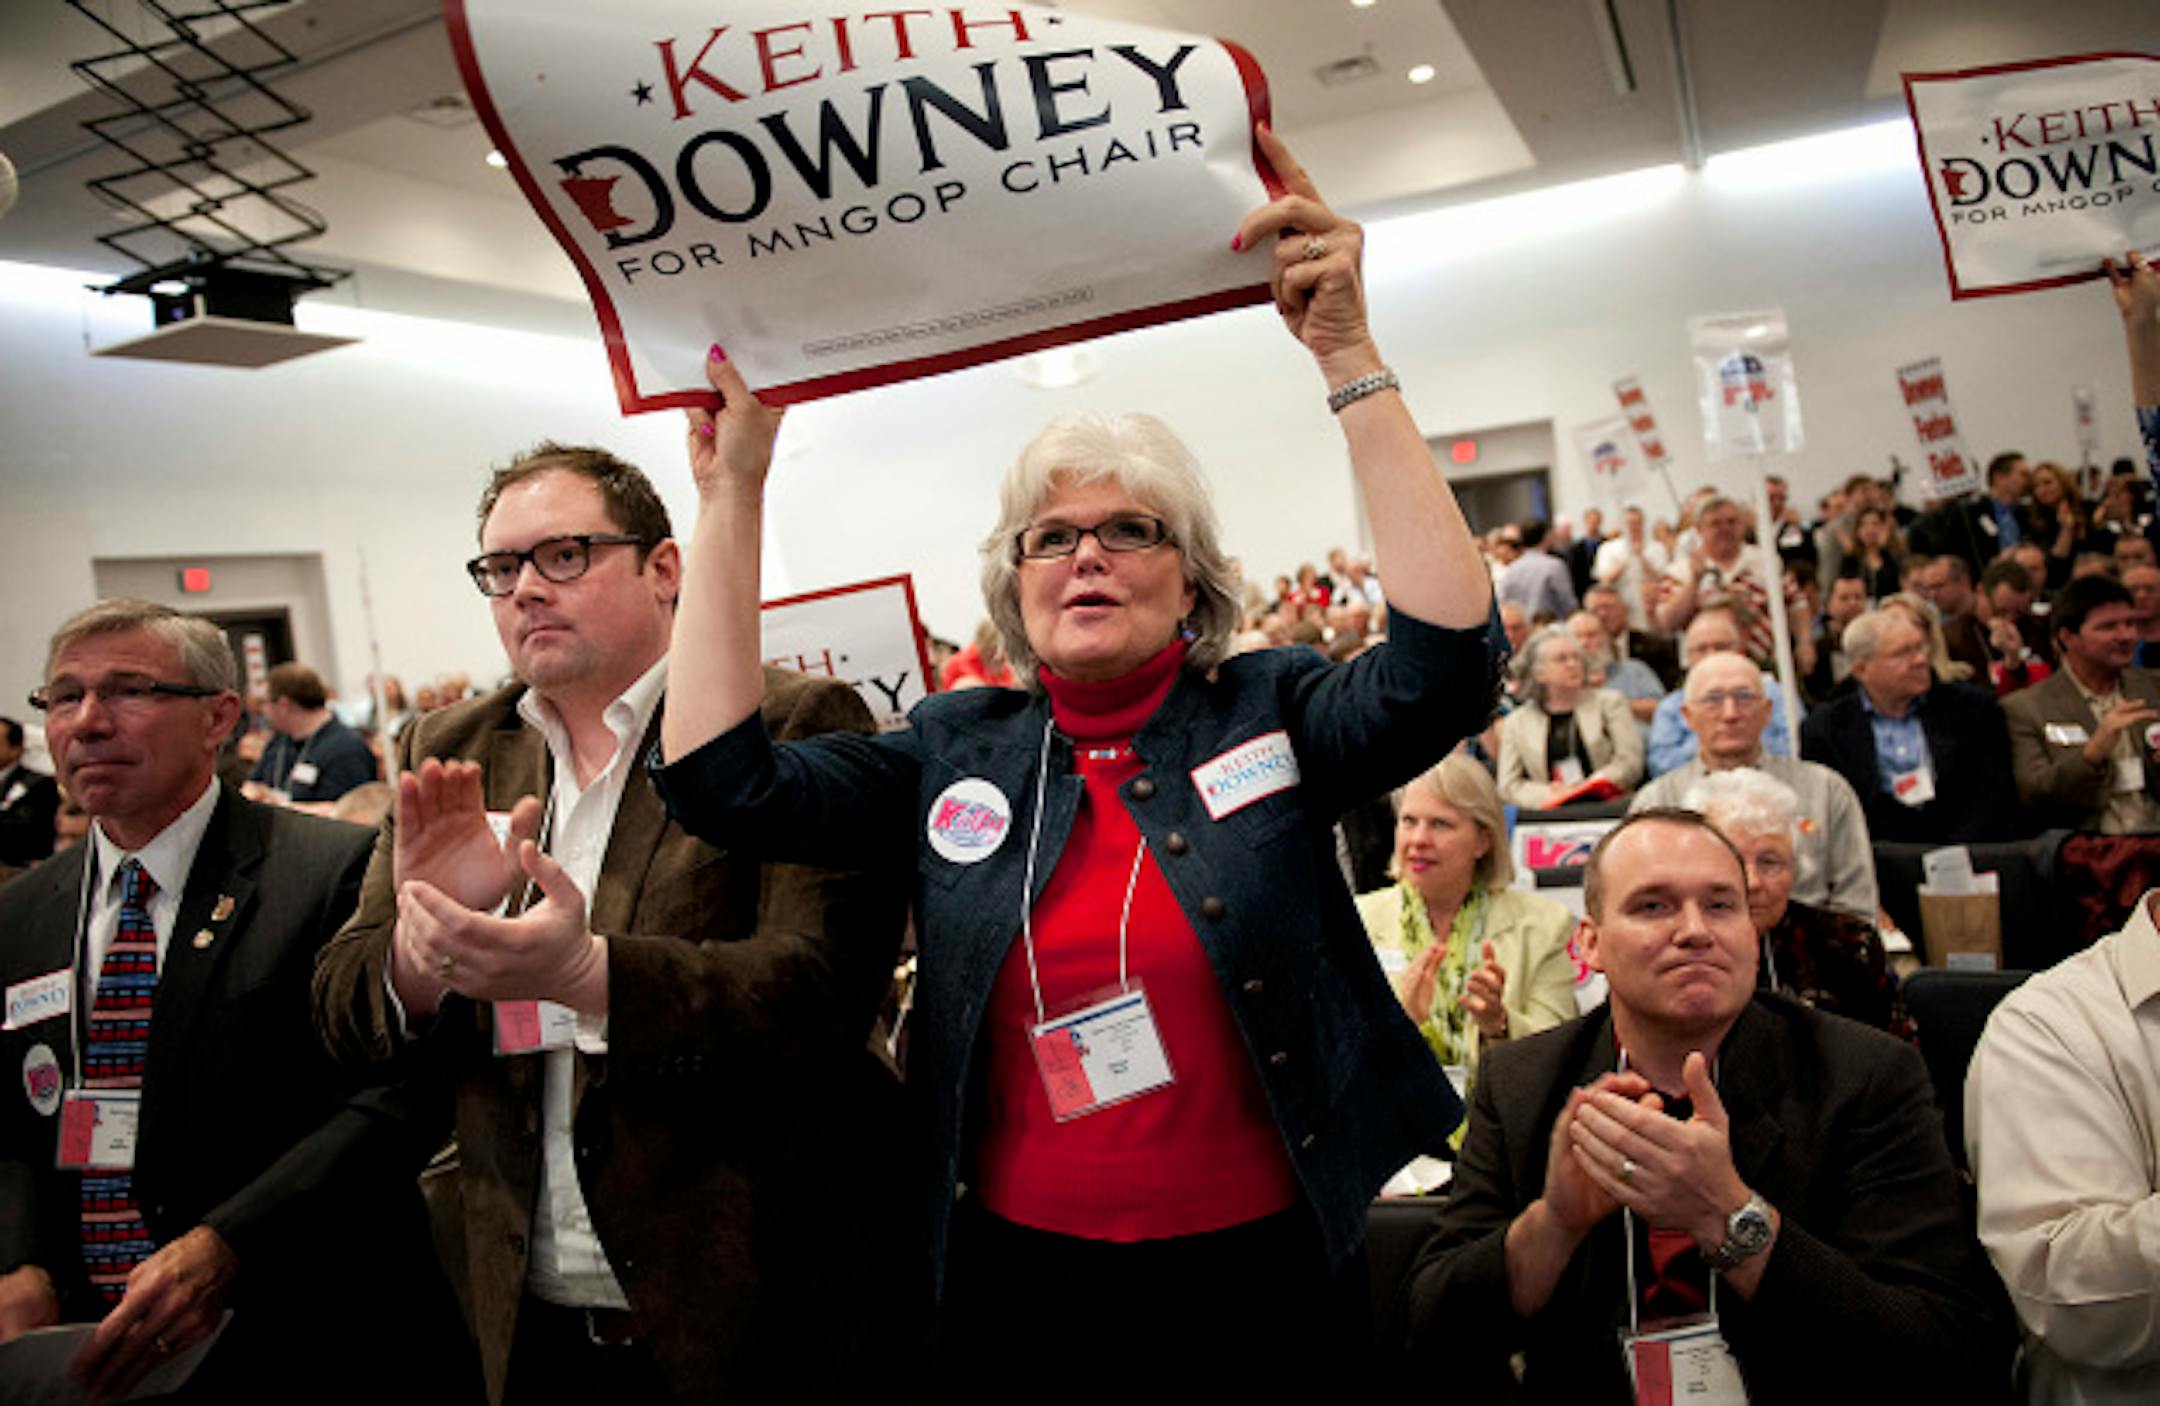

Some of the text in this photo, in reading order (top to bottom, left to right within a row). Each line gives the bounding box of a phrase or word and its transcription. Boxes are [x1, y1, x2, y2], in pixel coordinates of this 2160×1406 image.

[652, 9, 1035, 121] KEITH
[552, 44, 1199, 250] DOWNEY
[1940, 133, 2157, 206] DOWN
[1991, 98, 2160, 153] KEITH
[617, 122, 1203, 285] FOR MNGOP CHAIR
[1951, 207, 2008, 225] FOR
[2021, 186, 2133, 217] MNGOP
